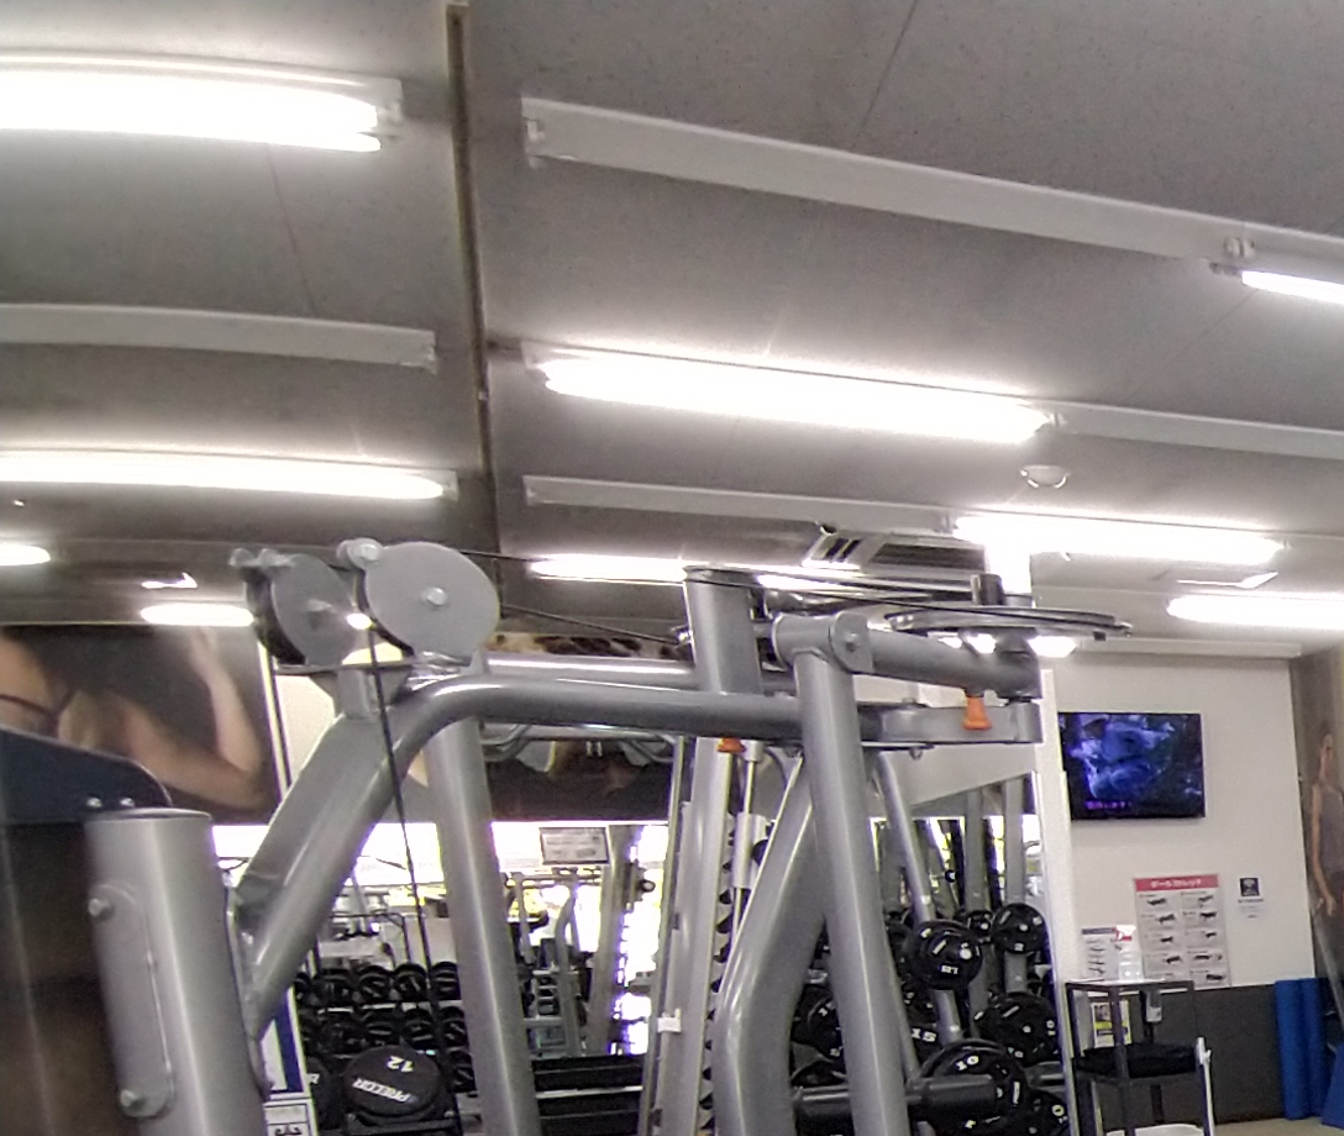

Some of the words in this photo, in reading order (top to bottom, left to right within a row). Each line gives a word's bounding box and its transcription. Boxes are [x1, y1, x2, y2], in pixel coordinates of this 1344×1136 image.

[910, 1027, 938, 1043] 15
[386, 1055, 415, 1073] 12
[955, 1054, 980, 1071] 10
[352, 1077, 411, 1103] PRECOR
